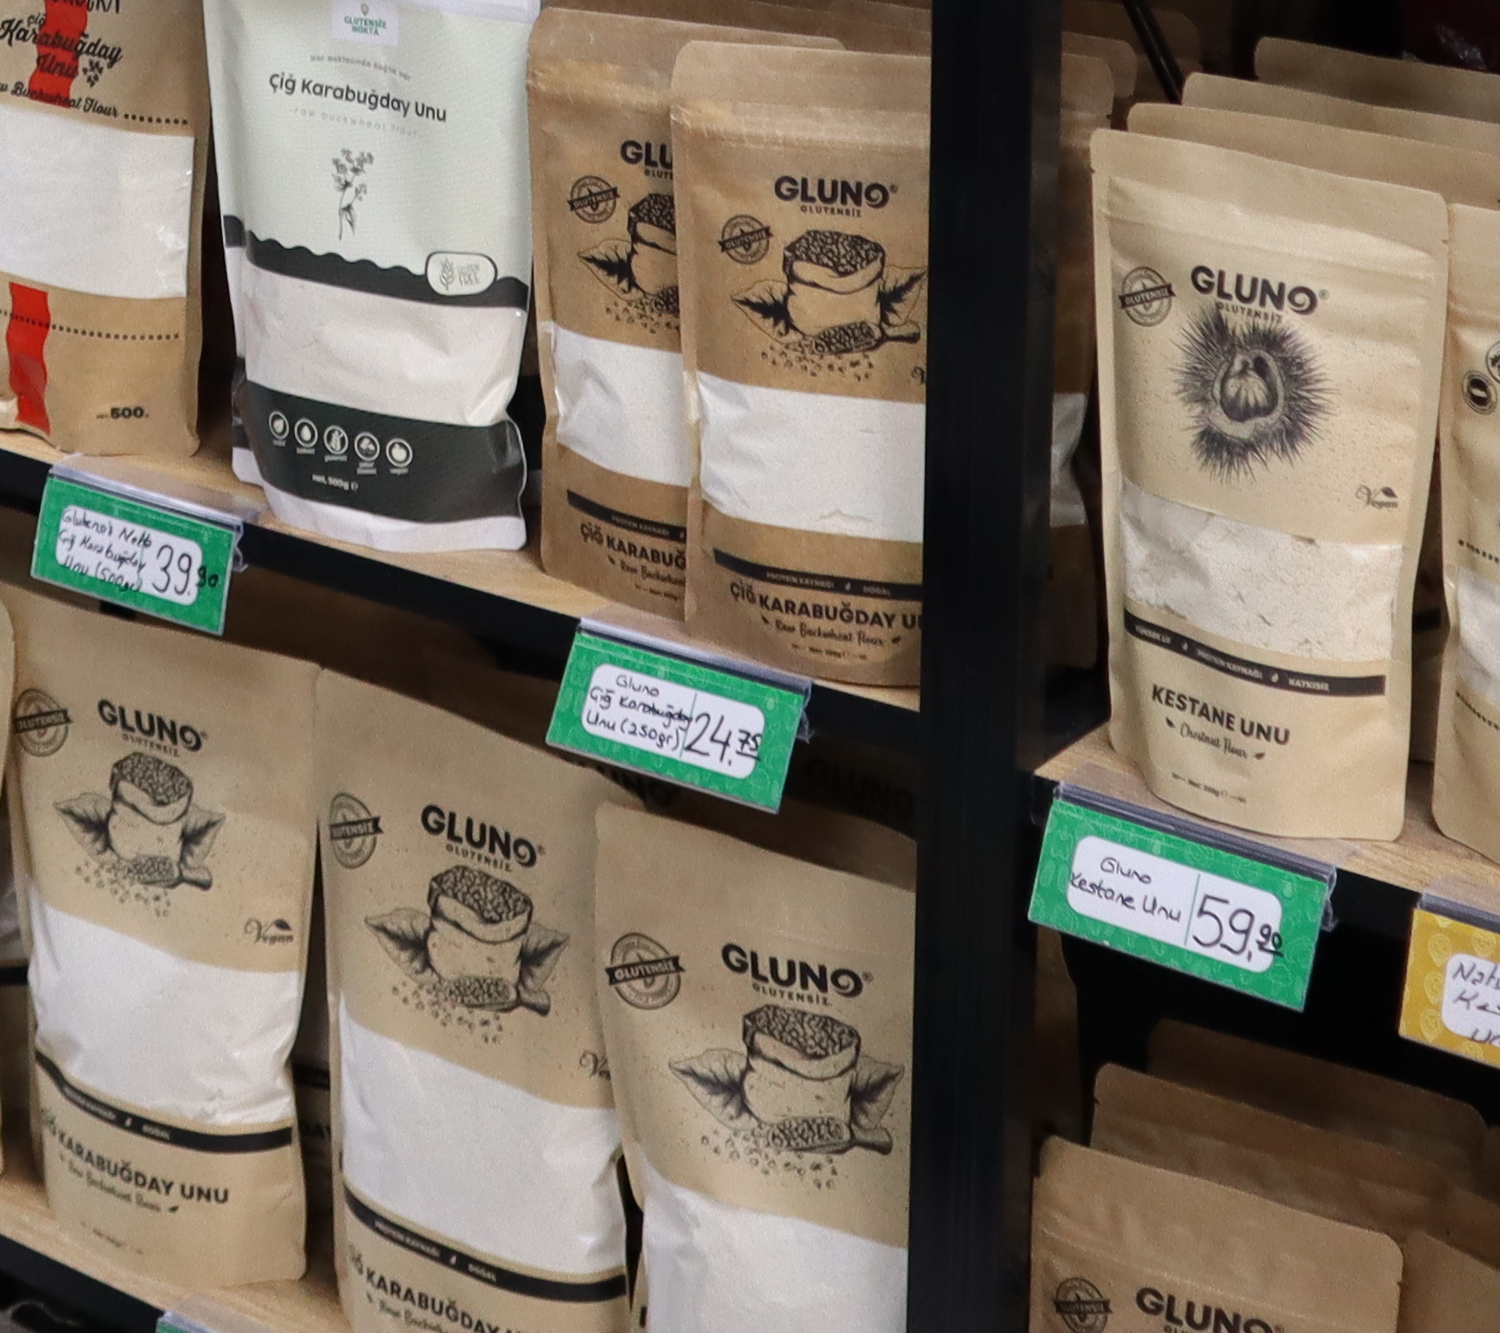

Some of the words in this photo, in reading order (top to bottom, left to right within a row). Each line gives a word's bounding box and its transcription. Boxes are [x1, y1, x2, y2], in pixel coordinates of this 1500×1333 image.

[36, 47, 79, 81] Unu
[269, 71, 297, 96] Çiğ
[300, 77, 411, 118] Karabuğday
[415, 103, 447, 123] Unu
[773, 174, 891, 210] GLUNO
[1189, 263, 1318, 317] GLUNO
[758, 593, 898, 633] KARABUĞDAY
[615, 673, 660, 698] Gluno
[97, 697, 204, 753] GLUNO
[586, 711, 616, 732] Unu
[1151, 684, 1239, 737] KESTANE
[1239, 715, 1291, 747] UNU
[420, 803, 537, 868] GLUNO
[1141, 889, 1183, 925] Unu
[721, 941, 863, 999] GLUNO
[179, 1183, 230, 1207] UNU
[1135, 1285, 1277, 1333] GLUNO
